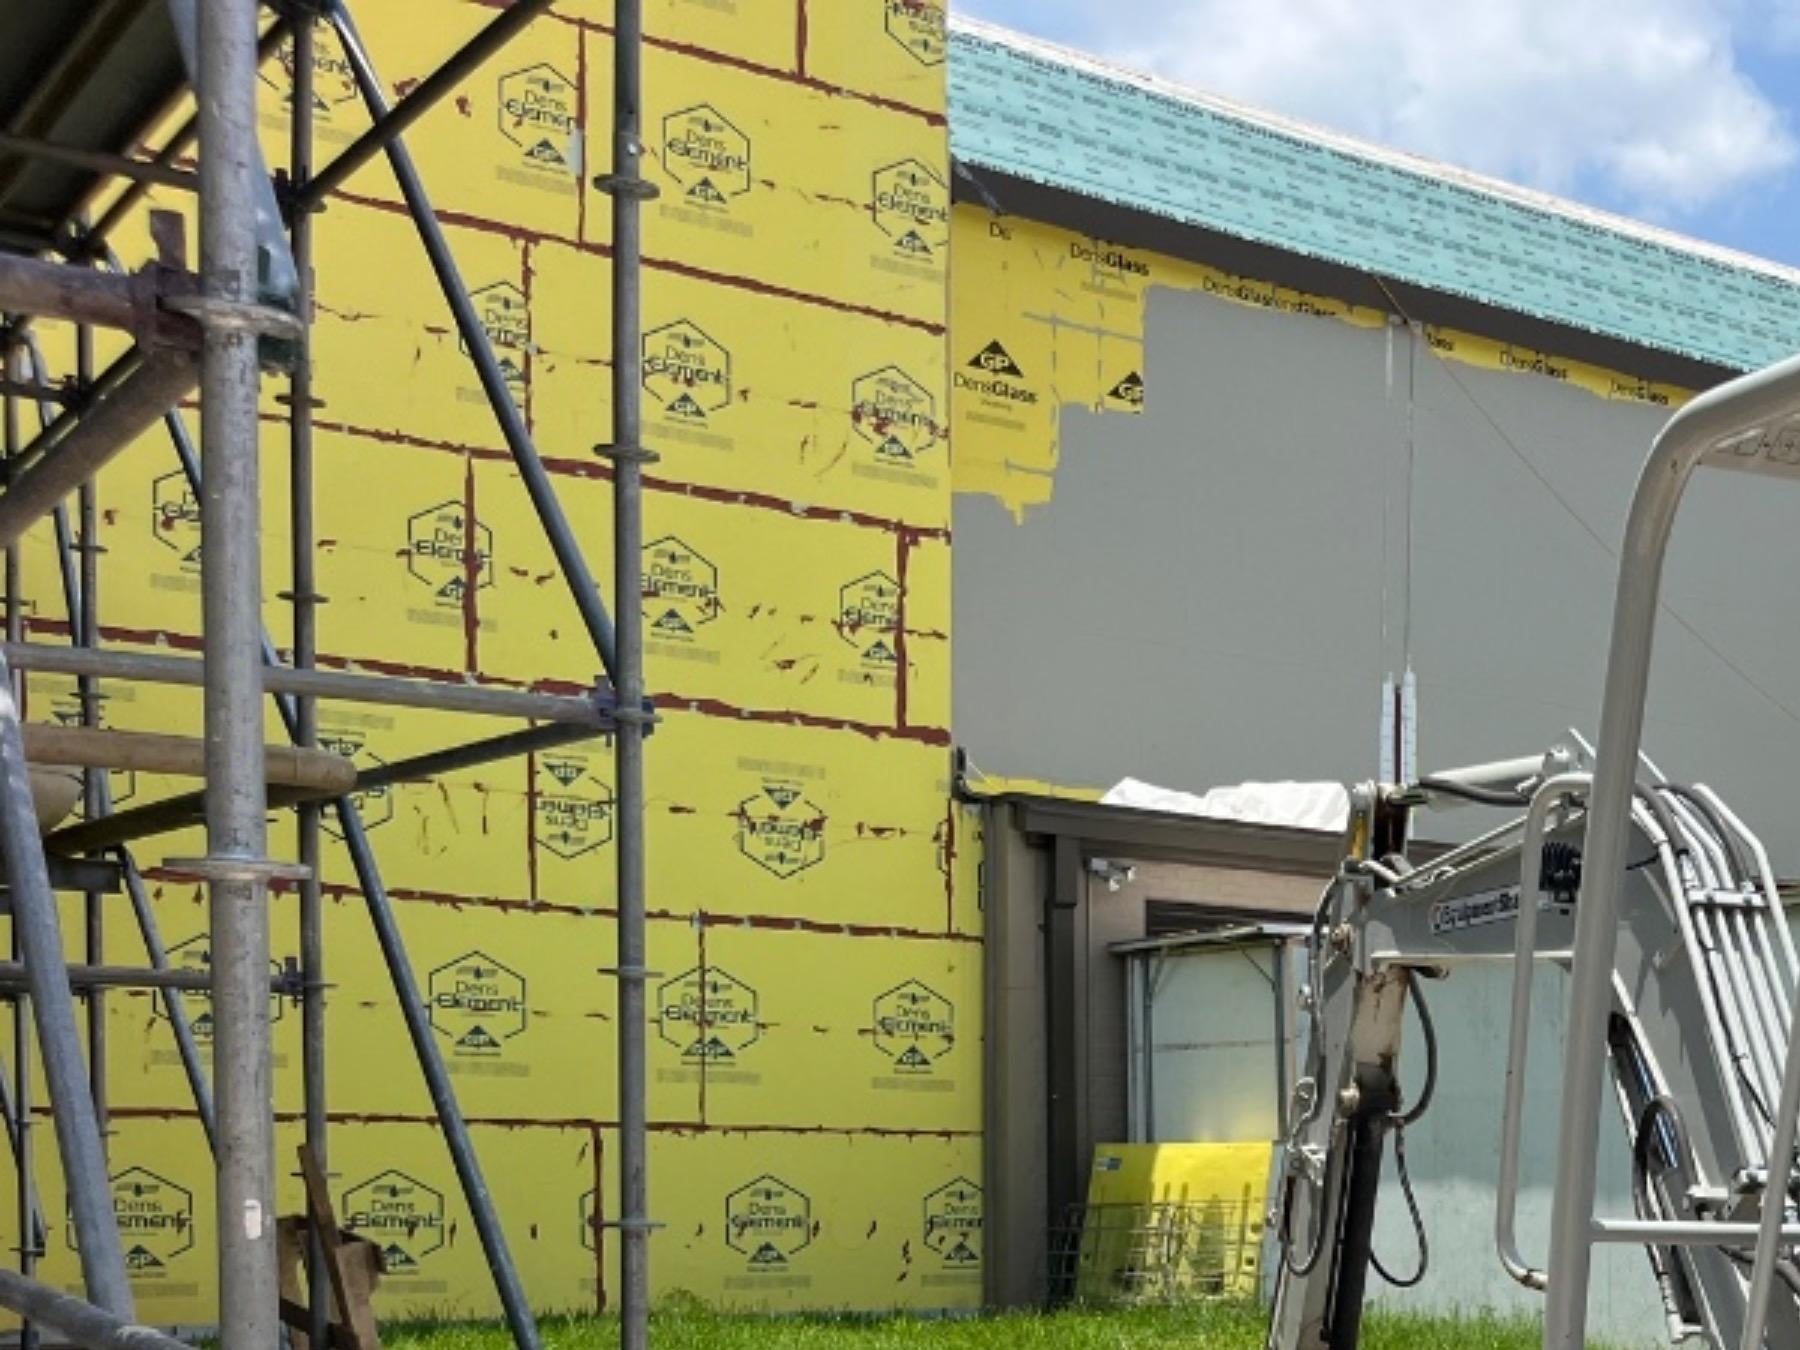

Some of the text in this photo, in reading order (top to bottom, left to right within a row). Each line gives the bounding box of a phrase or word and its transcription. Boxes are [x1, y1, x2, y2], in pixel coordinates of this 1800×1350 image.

[687, 128, 726, 151] Dens
[894, 183, 930, 205] Dens
[1070, 242, 1150, 276] DensGlass
[666, 346, 706, 366] Dens
[954, 374, 1037, 403] DensGlass
[651, 563, 691, 581] Dens
[456, 980, 498, 996] Dens
[437, 992, 520, 1013] Element
[896, 1005, 930, 1020] Dens
[114, 1198, 162, 1212] Dens
[371, 1200, 415, 1214] Dens
[945, 1203, 979, 1217] Dens
[349, 1211, 441, 1229] Element
